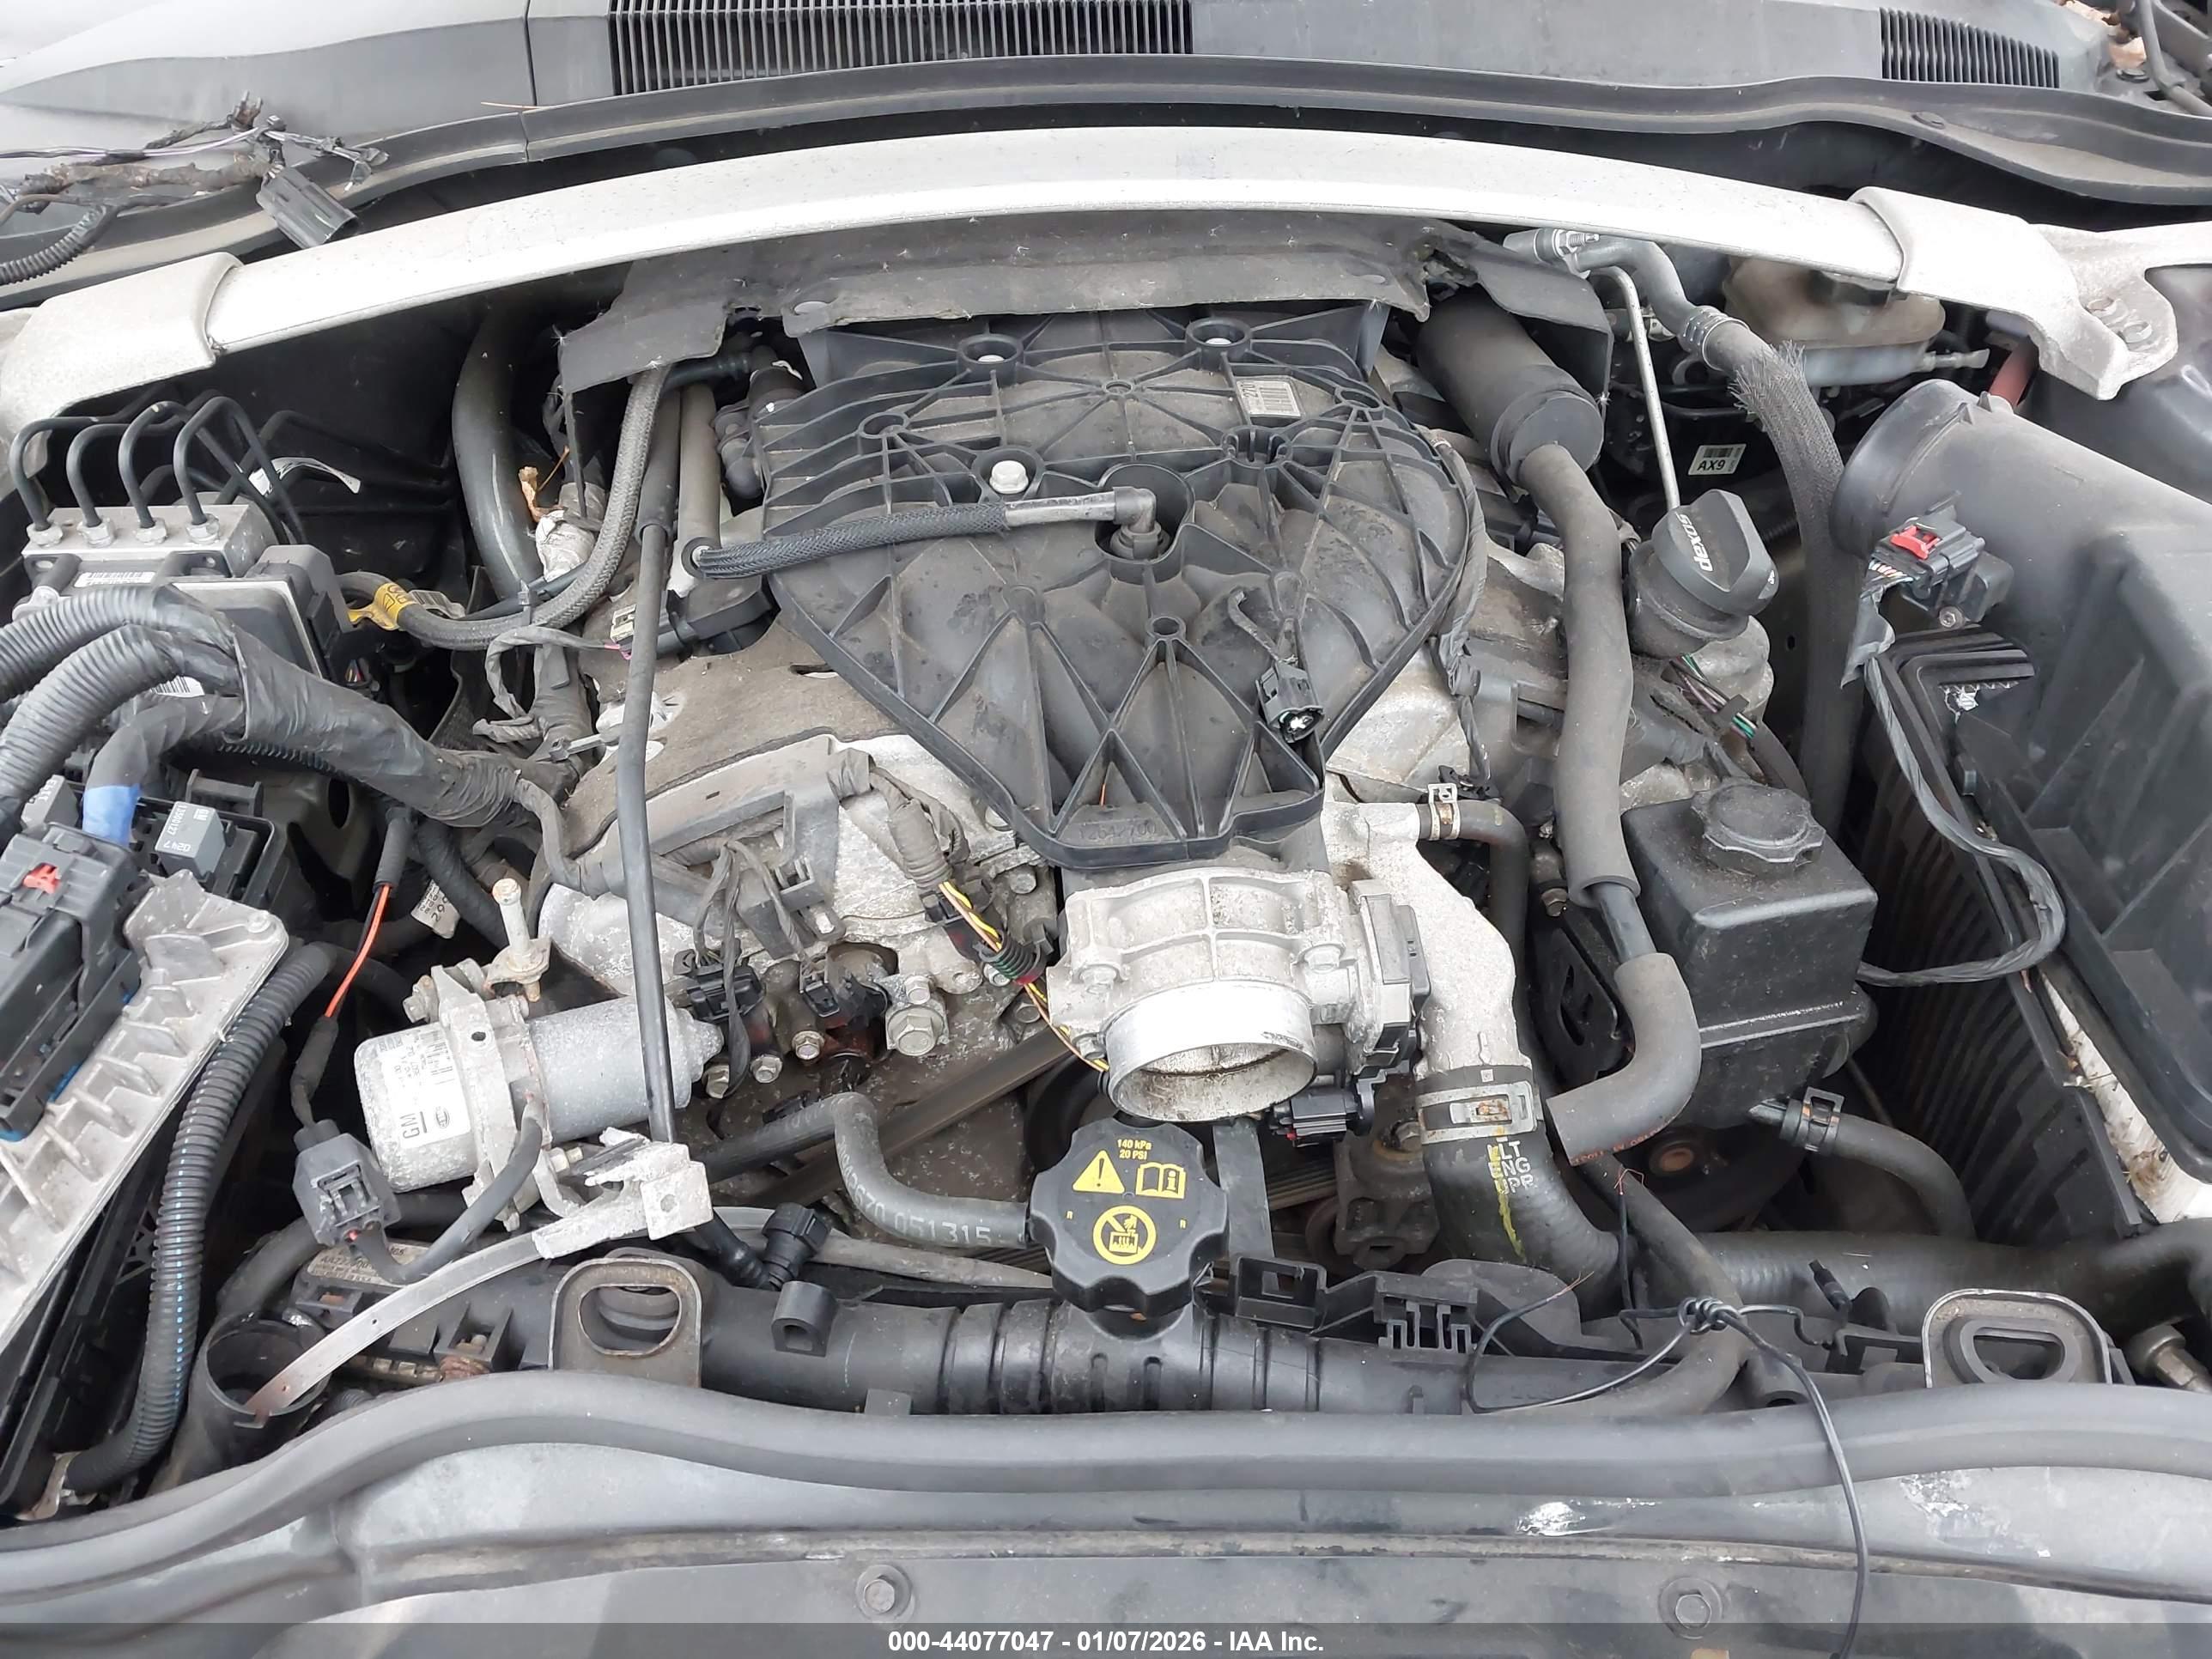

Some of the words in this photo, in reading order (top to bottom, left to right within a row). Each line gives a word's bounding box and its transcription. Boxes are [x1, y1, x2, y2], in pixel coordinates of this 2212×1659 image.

[1696, 459, 1726, 471] AX9
[1680, 514, 1713, 572] dexos
[399, 1112, 421, 1139] GM
[1117, 1139, 1133, 1149] 140
[1134, 1140, 1152, 1151] kPa
[1119, 1150, 1131, 1159] 20
[1132, 1151, 1148, 1160] PSI
[1487, 1157, 1532, 1180] ENG
[1494, 1174, 1534, 1195] UPR
